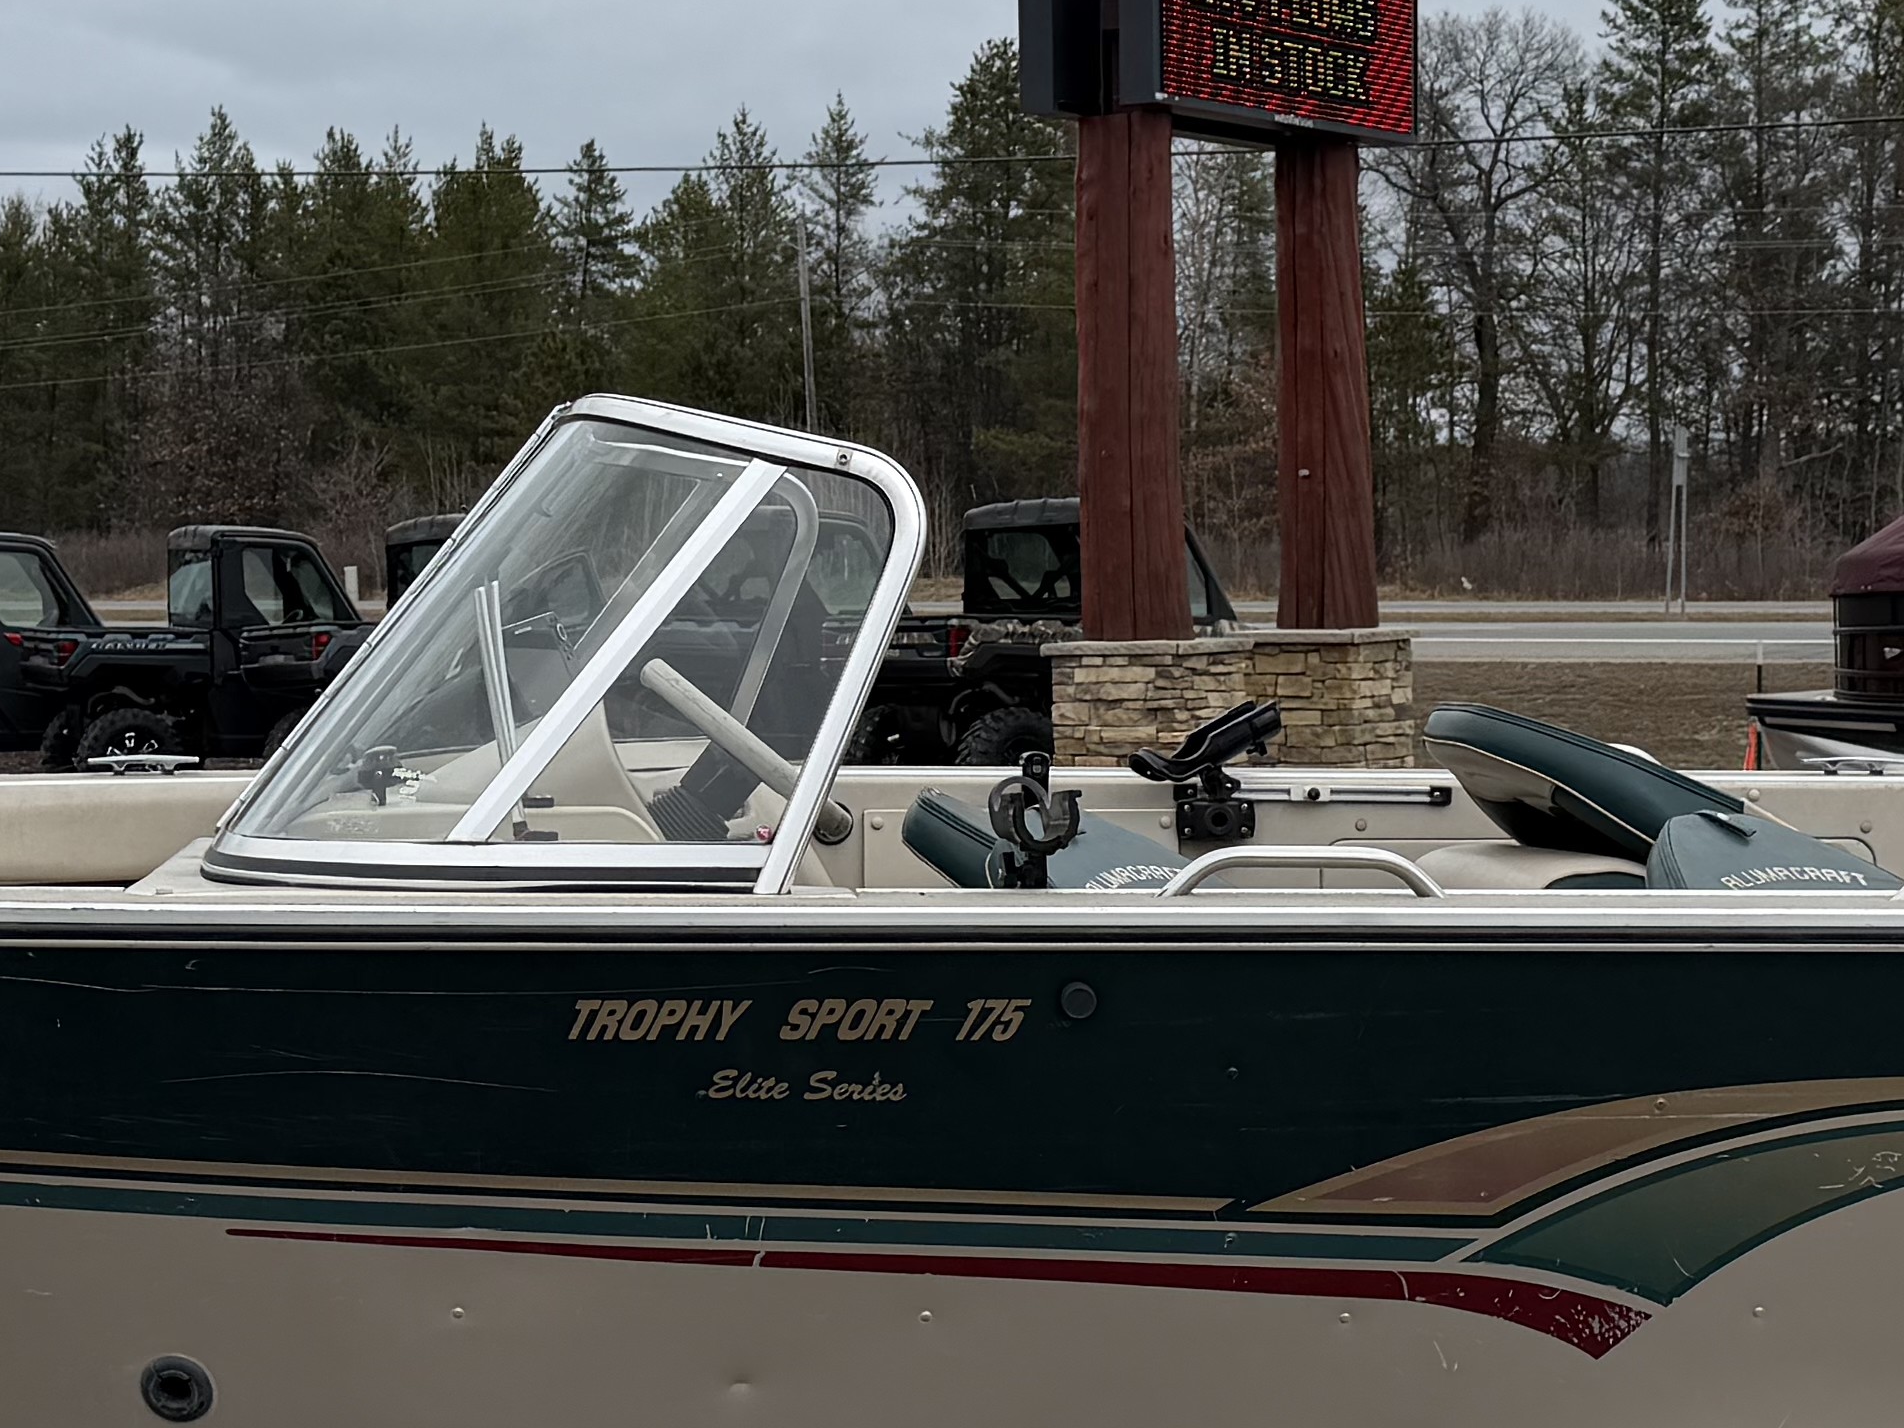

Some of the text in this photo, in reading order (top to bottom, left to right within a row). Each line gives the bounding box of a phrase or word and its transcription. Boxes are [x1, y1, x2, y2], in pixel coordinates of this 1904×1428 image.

[1212, 27, 1368, 101] IN STOCK
[1720, 866, 1869, 891] ALUMACRAFT
[567, 998, 1033, 1042] TROPHY SPORT 175
[706, 1069, 908, 1103] Elite Series
